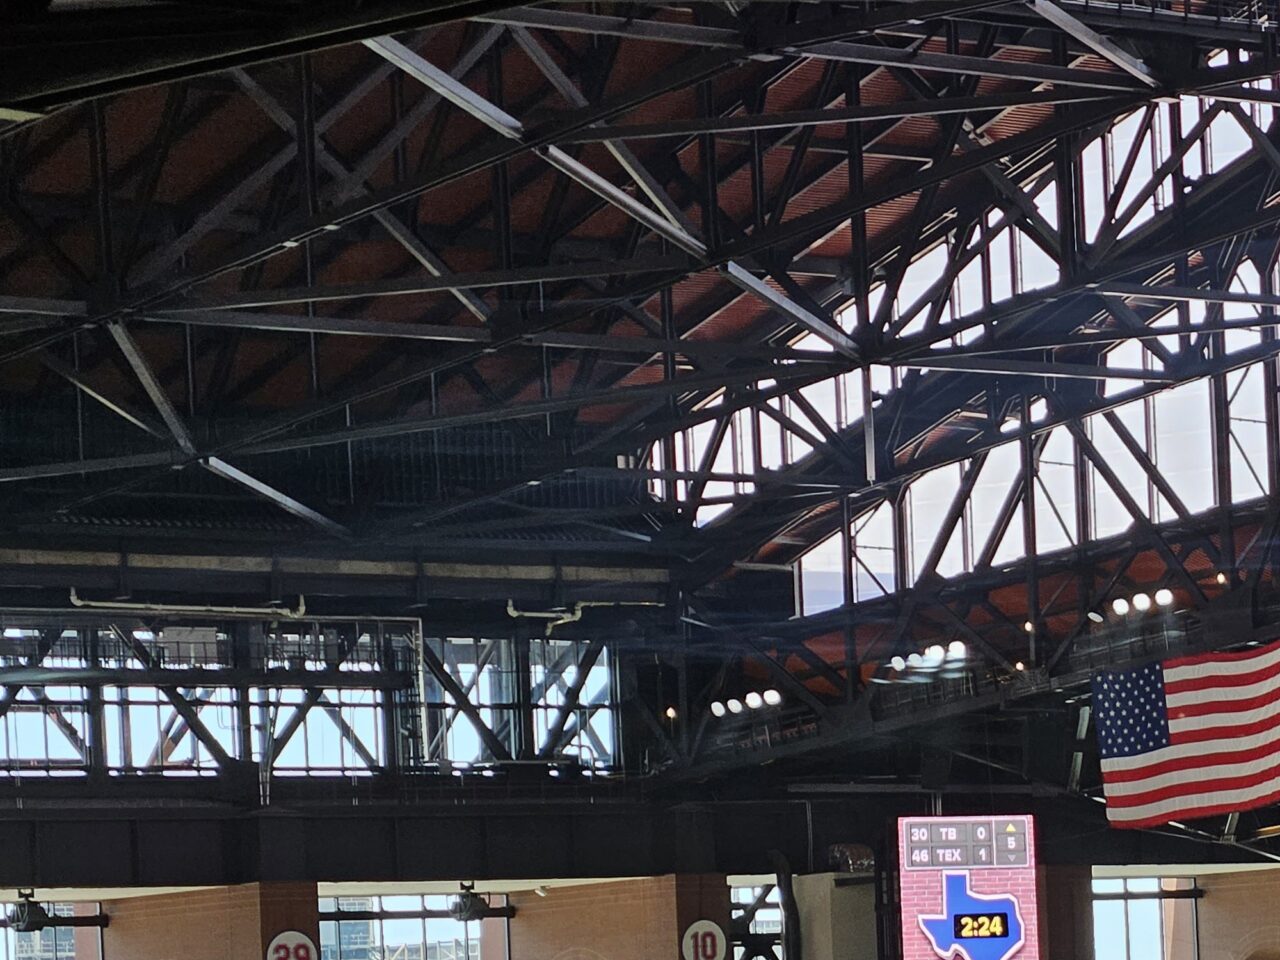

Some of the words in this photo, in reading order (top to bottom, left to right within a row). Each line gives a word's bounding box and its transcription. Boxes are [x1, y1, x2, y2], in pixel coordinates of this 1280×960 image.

[911, 827, 928, 841] 30
[940, 827, 957, 841] TB
[976, 826, 986, 840] 0
[1007, 836, 1016, 849] 5
[911, 849, 929, 862] 46
[936, 848, 962, 862] TEX
[979, 848, 986, 861] 1
[960, 915, 1004, 938] 2:24
